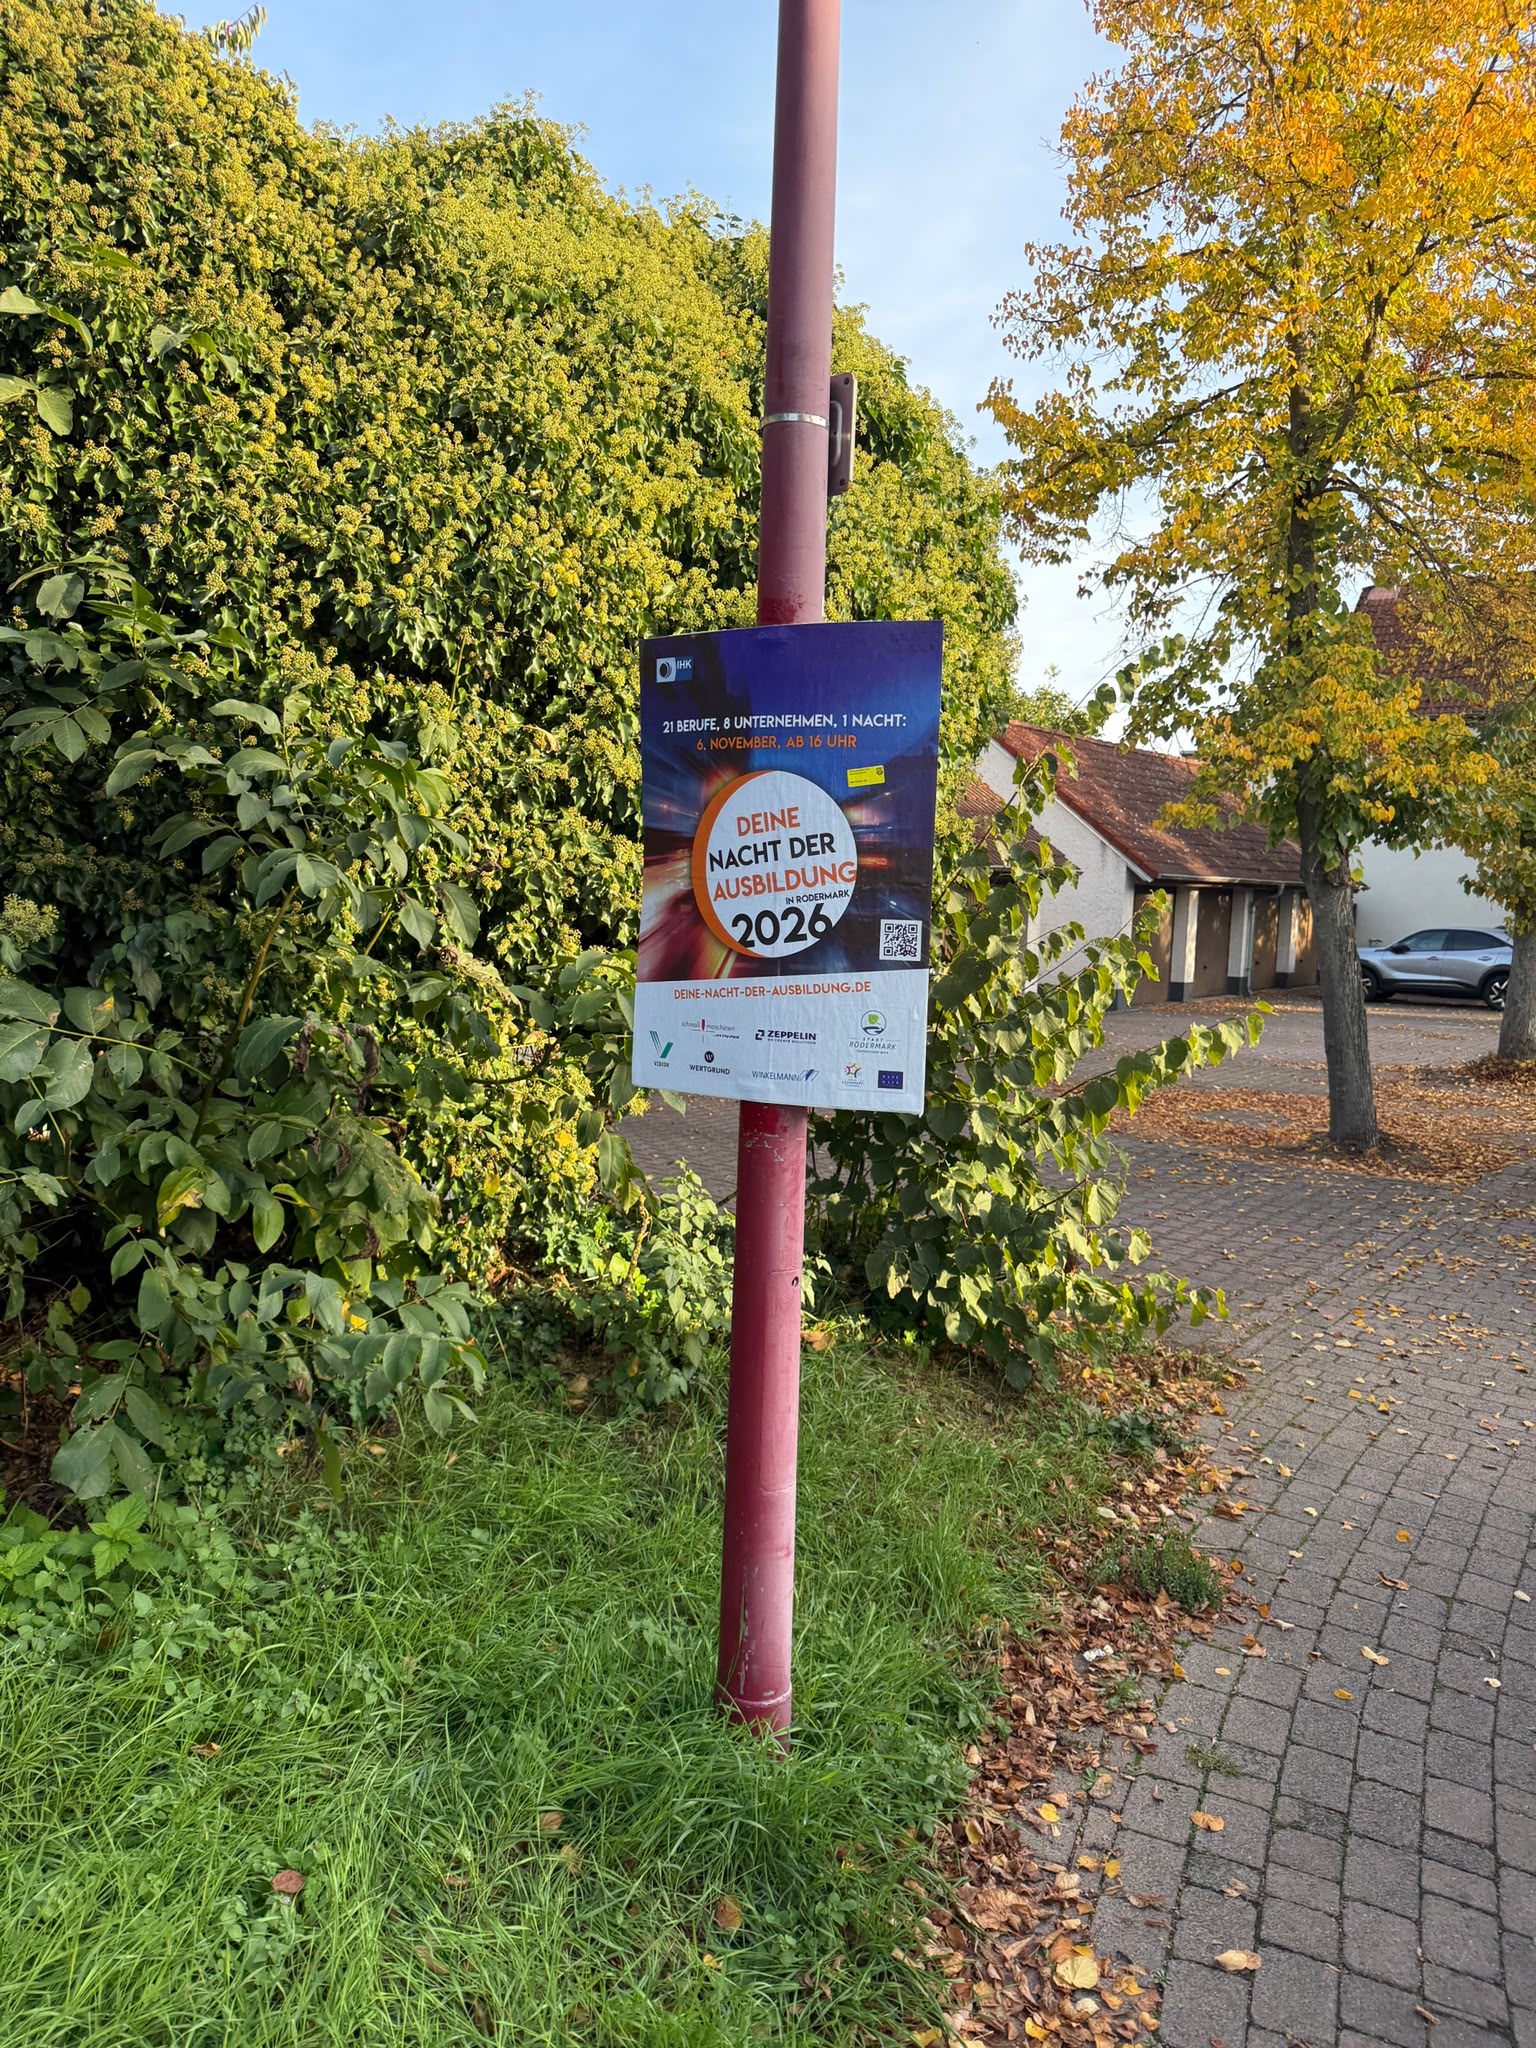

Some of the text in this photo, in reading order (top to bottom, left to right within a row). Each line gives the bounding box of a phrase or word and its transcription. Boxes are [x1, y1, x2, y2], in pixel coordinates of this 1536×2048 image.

[677, 659, 692, 670] IHK
[663, 714, 907, 733] 21 BERUFE, 8 UNTERNEHMEN, 1 NACHT:
[696, 734, 857, 751] 6. NOVEMBER, AB 16 UHR
[736, 806, 801, 837] DEINE
[708, 832, 836, 872] NACHT DER
[713, 861, 857, 902] AUSBILDUNG
[785, 896, 794, 905] IN
[731, 903, 833, 948] 2026
[674, 981, 871, 1000] DEINE-NACHT-DER-AUSBILDUNG.DE
[767, 1029, 817, 1041] ZEPPELIN
[689, 1064, 731, 1075] WERTGRUND
[751, 1070, 800, 1082] WINKELMANN
